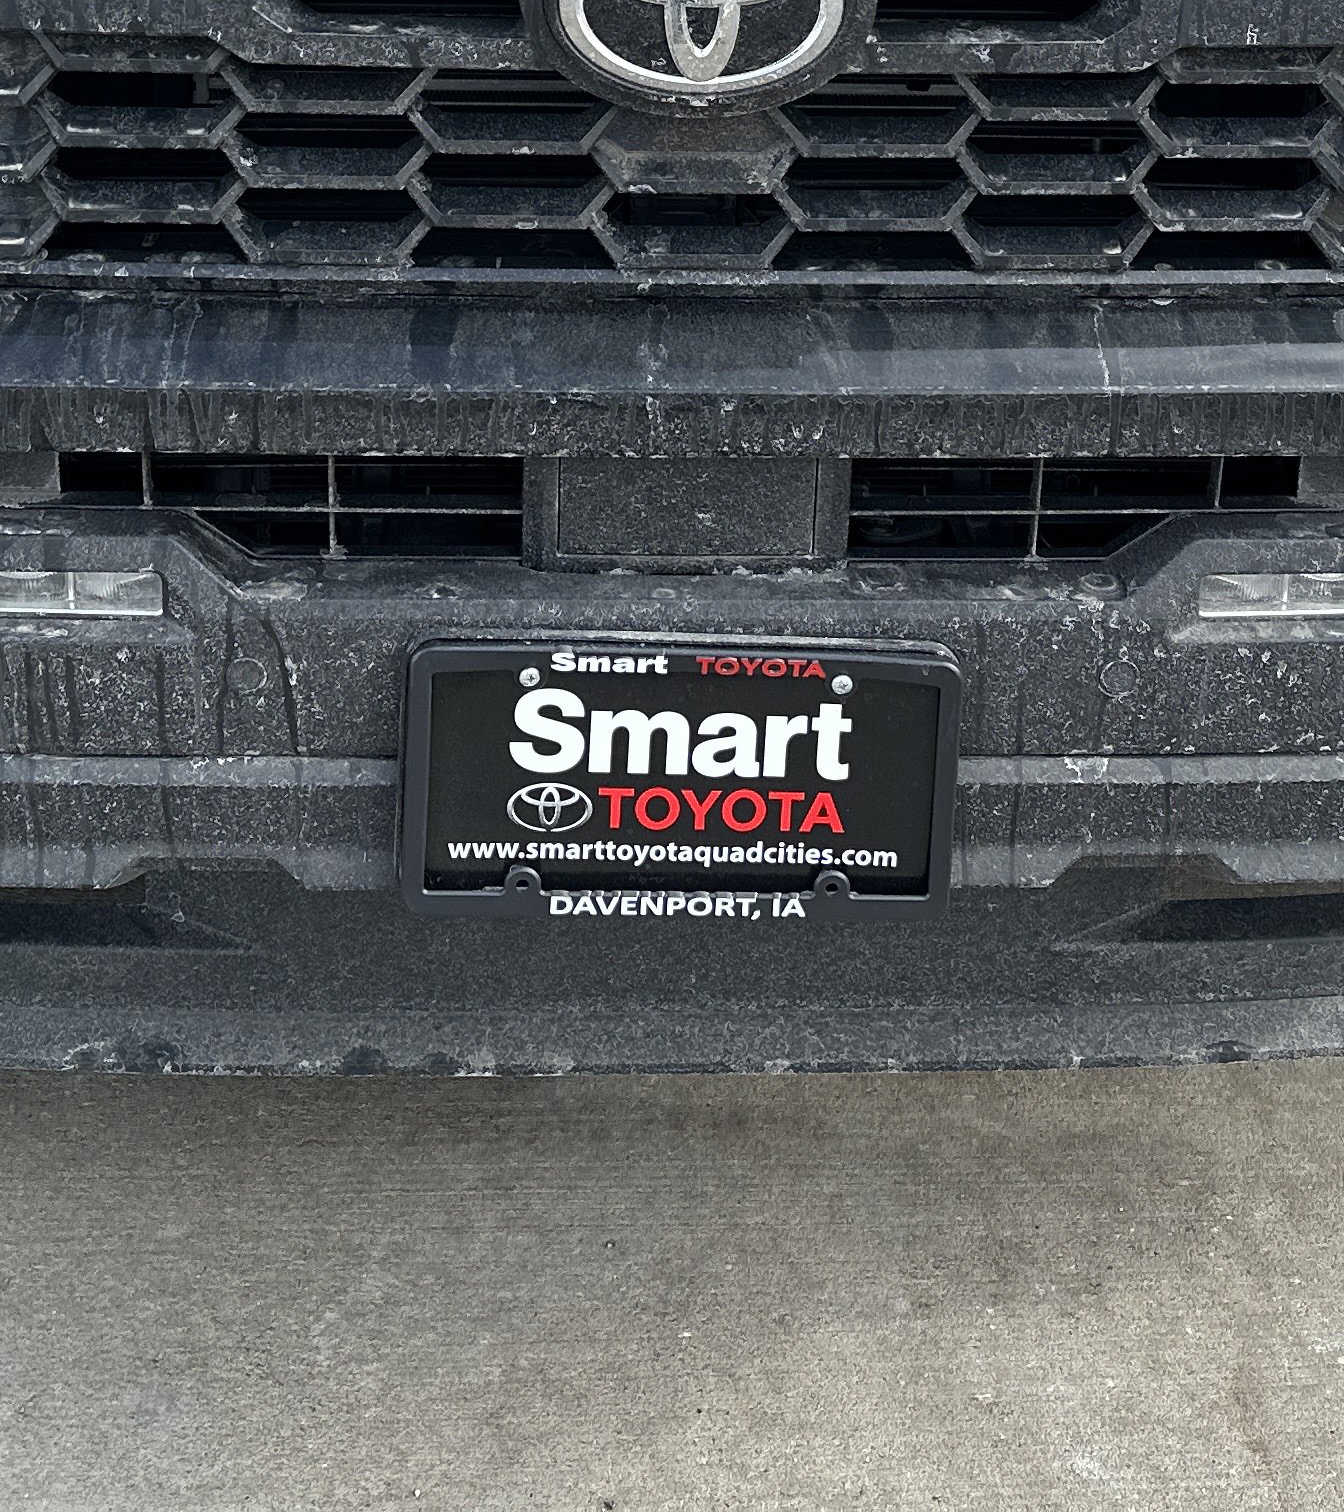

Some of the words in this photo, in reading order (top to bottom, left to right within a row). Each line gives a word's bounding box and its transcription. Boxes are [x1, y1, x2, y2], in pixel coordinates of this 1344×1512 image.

[550, 652, 669, 676] Smart
[696, 655, 826, 679] TOYOTA
[508, 687, 853, 781] Smart
[598, 786, 846, 833] TOYOTA
[447, 839, 898, 868] www.smarttoyotaquadcities.com
[549, 893, 761, 920] DAVENPORT,
[772, 895, 806, 918] IA
